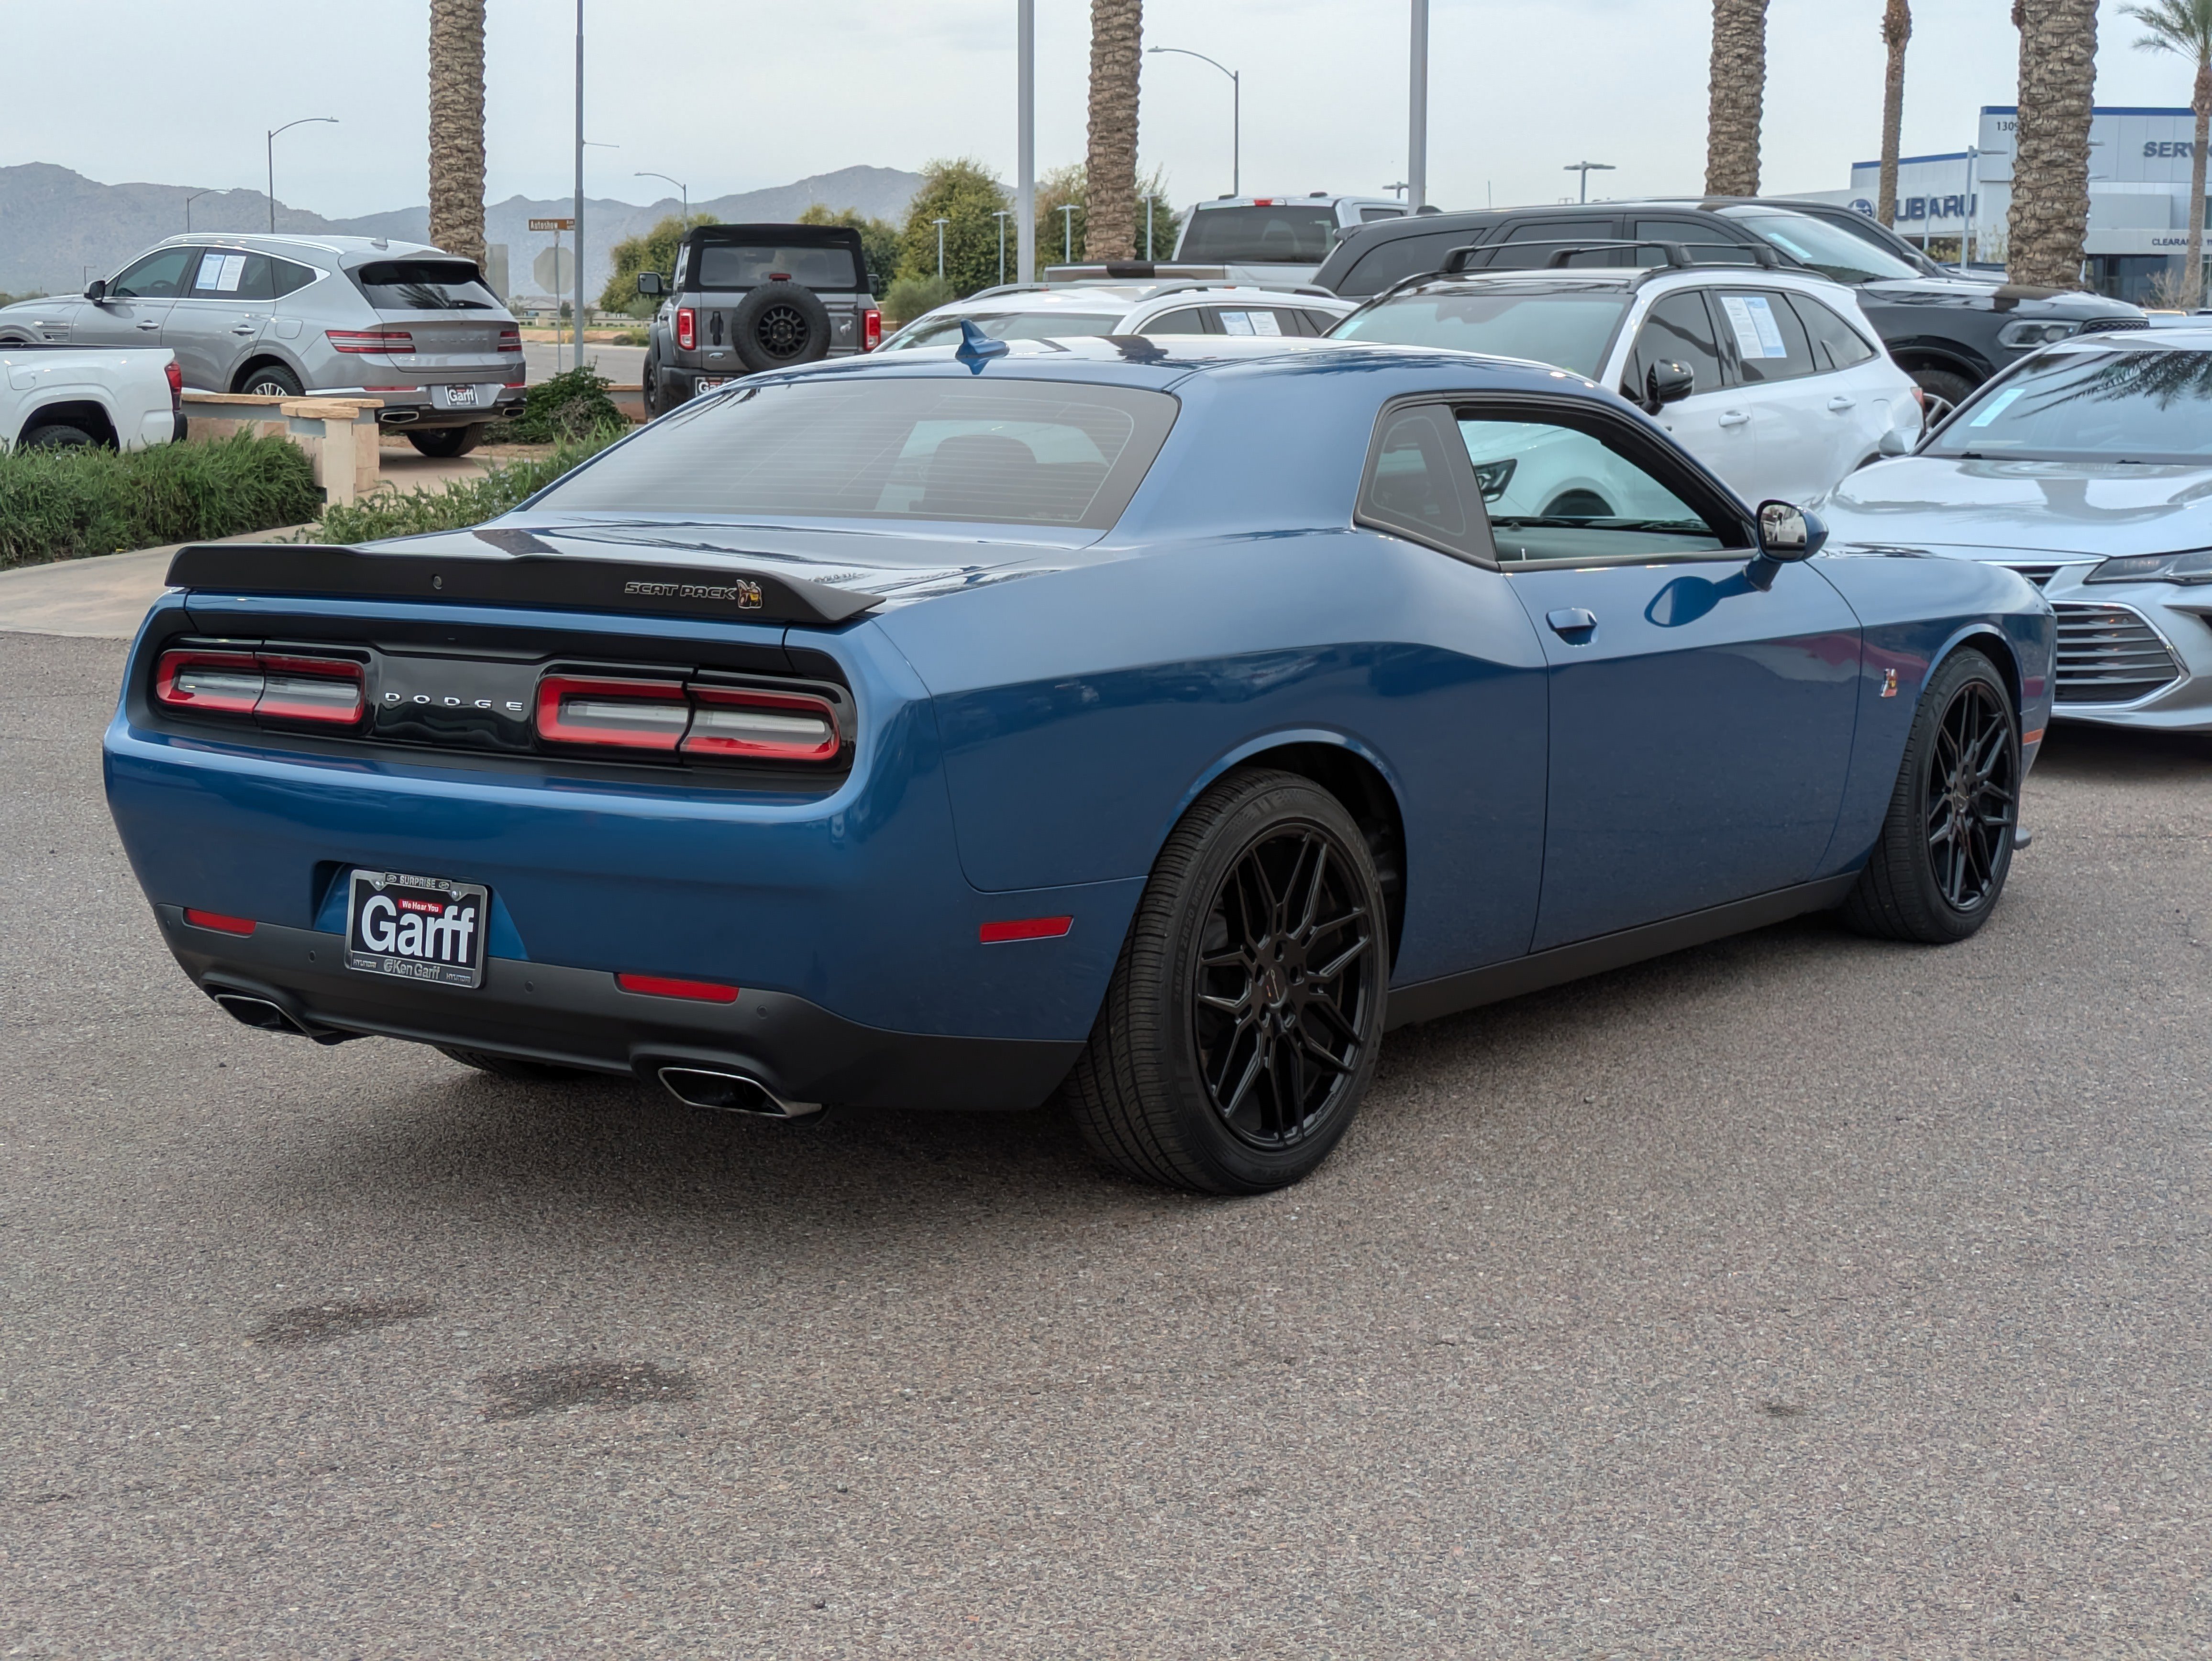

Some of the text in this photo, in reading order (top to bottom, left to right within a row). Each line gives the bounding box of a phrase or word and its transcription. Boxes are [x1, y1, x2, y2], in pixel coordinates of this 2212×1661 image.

[1895, 194, 1977, 221] UBARU
[449, 389, 474, 401] Garff
[624, 582, 738, 600] SCAT PACK
[385, 692, 523, 711] DODGE
[400, 875, 436, 888] SURPRISE
[402, 900, 439, 912] We Hear You
[362, 895, 475, 963] Garff
[414, 963, 440, 980] Garff
